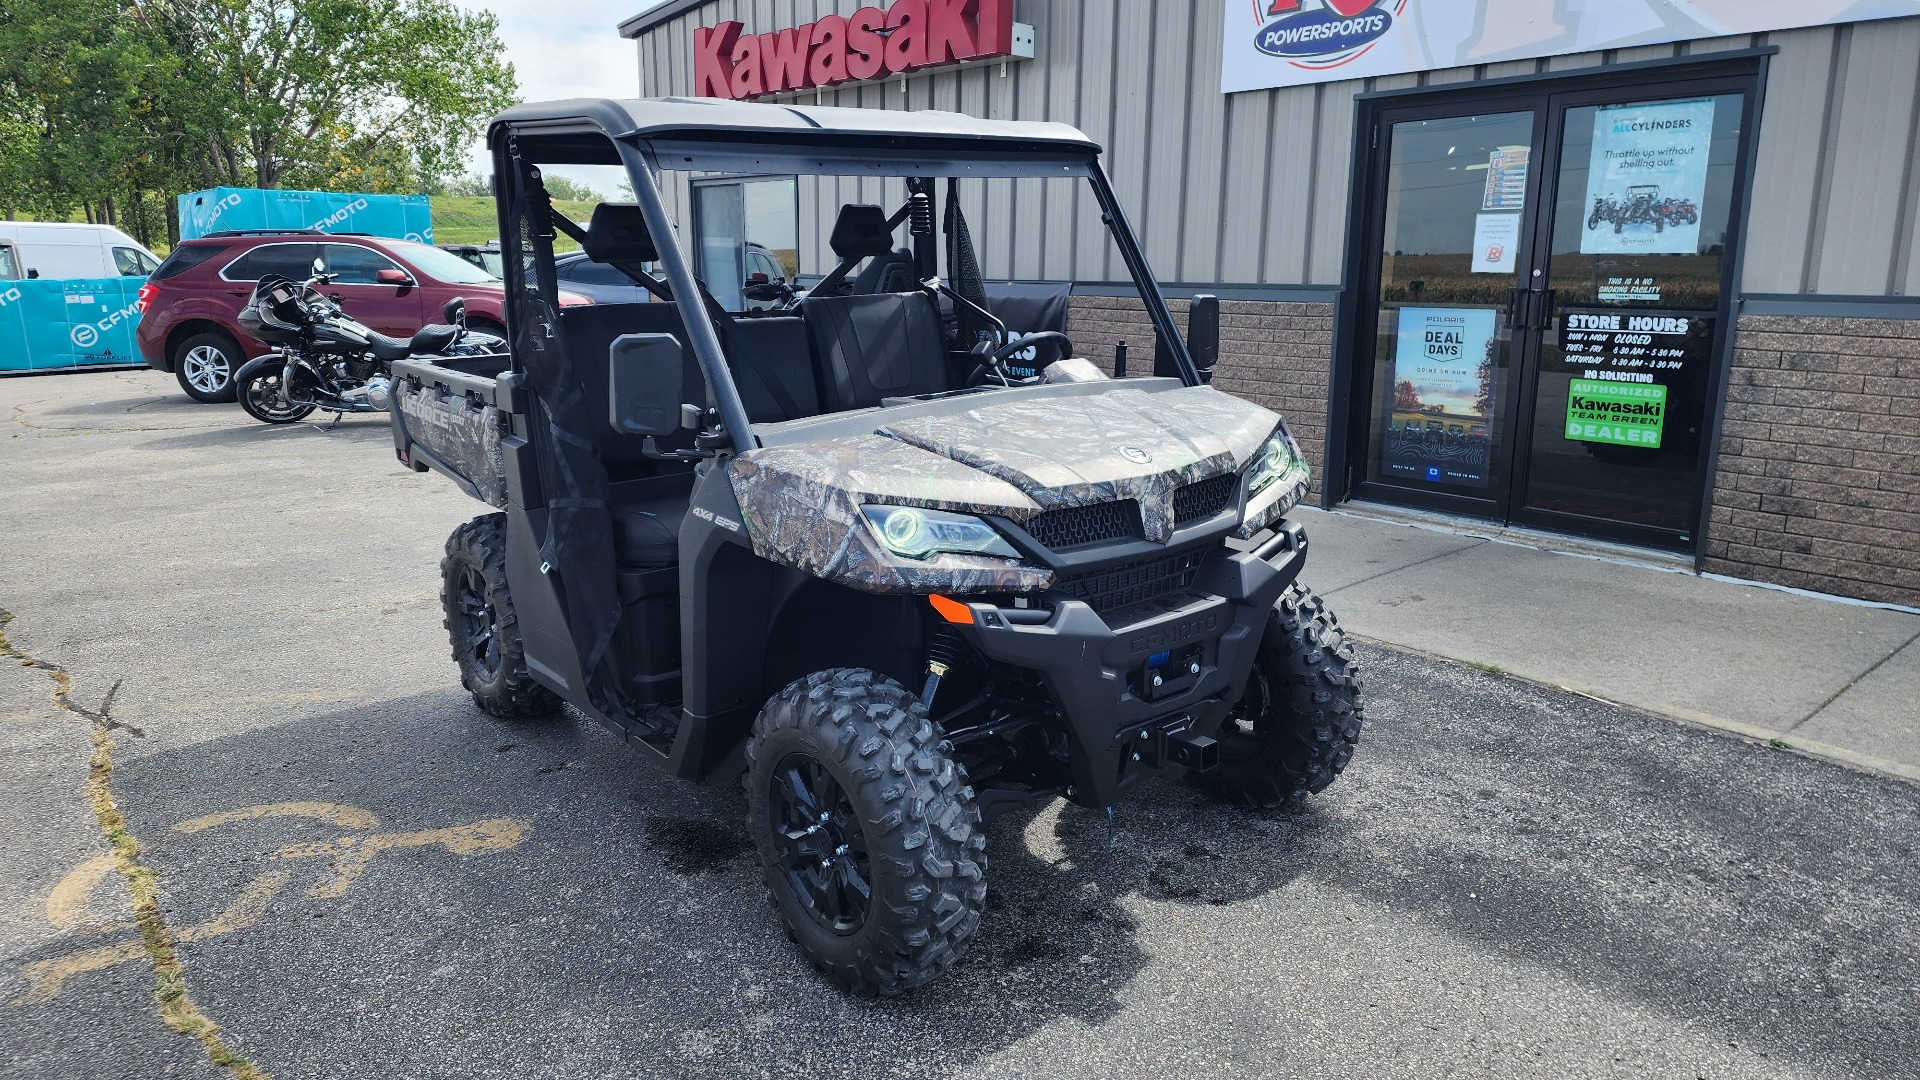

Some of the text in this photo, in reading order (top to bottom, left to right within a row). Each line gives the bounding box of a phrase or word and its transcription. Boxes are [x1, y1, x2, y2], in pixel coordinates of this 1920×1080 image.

[1263, 14, 1385, 47] POWERSPORTS
[693, 0, 1012, 100] Kawasaki
[1605, 146, 1695, 160] Throttle up without
[1619, 158, 1675, 169] shelling out.
[1599, 286, 1661, 294] SMOKING FACILITY
[1567, 314, 1690, 333] STORE HOURS
[1425, 331, 1464, 344] DEAL
[1567, 333, 1584, 341] SUN
[1588, 334, 1609, 342] MON
[1614, 334, 1652, 345] CLOSED
[1428, 344, 1458, 355] DAYS
[1565, 344, 1584, 352] TUES
[1589, 345, 1604, 353] FRI
[1631, 347, 1645, 356] AM
[1668, 350, 1684, 358] PM
[1564, 355, 1605, 364] SATURDAY
[1629, 358, 1643, 367] AM
[1667, 361, 1683, 370] PM
[1011, 366, 1036, 377] EVENT
[1584, 369, 1654, 384] NO SOLICITING
[1573, 383, 1663, 397] AUTHORIZED
[1571, 396, 1661, 417] Kawasaki
[1571, 411, 1659, 425] TEAM GREEN
[1568, 423, 1658, 444] DEALER
[714, 515, 740, 532] EPS
[1131, 614, 1217, 655] CFMOTO
